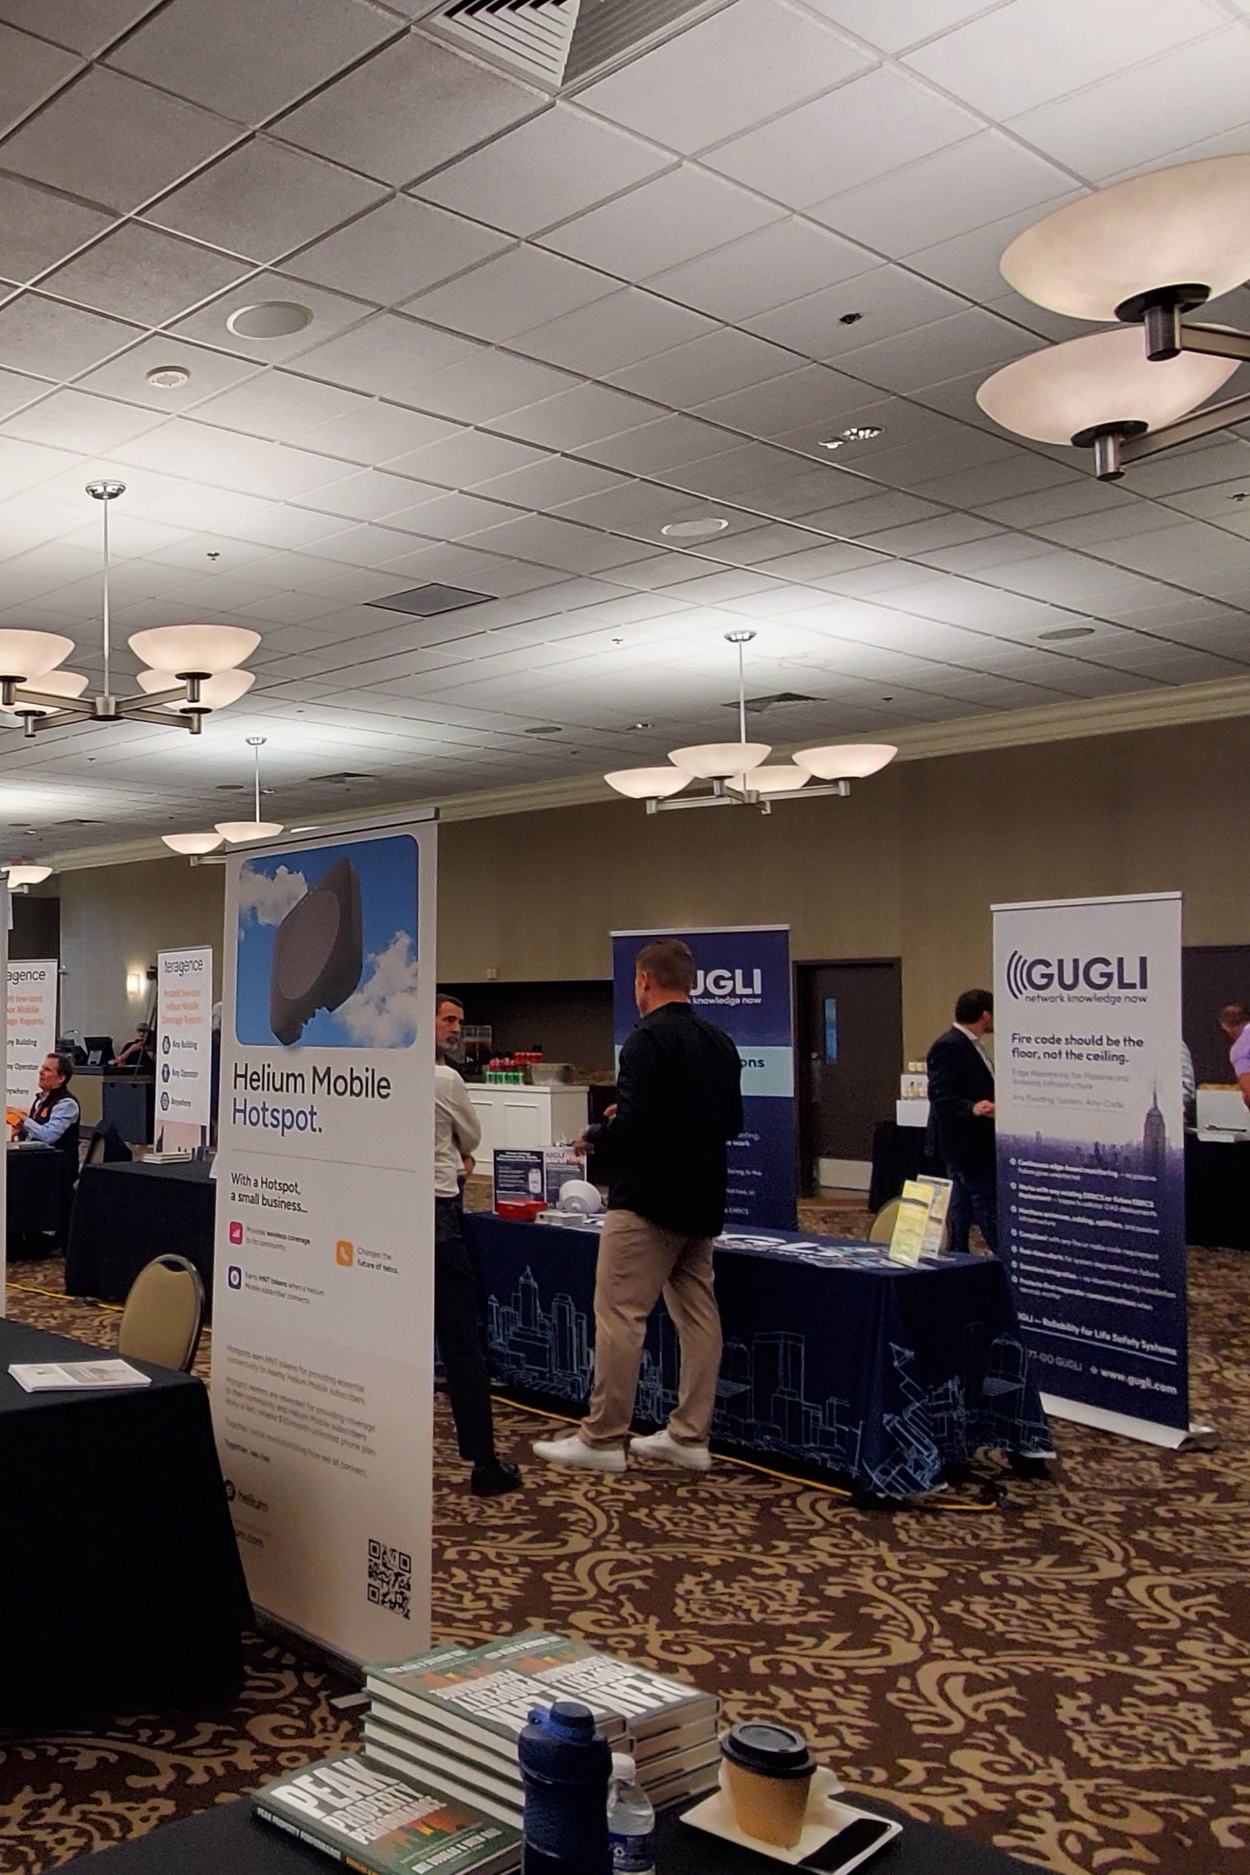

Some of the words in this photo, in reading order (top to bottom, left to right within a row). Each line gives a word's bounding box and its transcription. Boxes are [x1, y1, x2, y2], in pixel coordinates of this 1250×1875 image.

[7, 970, 46, 985] agence
[164, 958, 203, 977] teragence
[1026, 957, 1147, 991] GUGLI
[690, 969, 762, 996] UGLI
[693, 996, 740, 1006] knowledge
[1025, 993, 1065, 1003] network
[1068, 993, 1121, 1006] knowledge
[1125, 995, 1148, 1004] now
[1012, 1033, 1032, 1044] Fire
[1035, 1033, 1062, 1045] code
[1064, 1034, 1103, 1046] should
[1107, 1035, 1120, 1047] be
[1123, 1037, 1144, 1048] the
[1012, 1047, 1041, 1060] floor,
[1043, 1049, 1062, 1060] not
[1065, 1050, 1083, 1061] the
[1086, 1050, 1130, 1066] ceiling.
[6, 1088, 29, 1096] nywhere
[234, 1063, 305, 1094] Helium
[312, 1066, 391, 1099] Mobile
[233, 1097, 322, 1136] Hotspot.
[231, 1172, 251, 1186] With
[253, 1178, 259, 1187] a
[261, 1176, 301, 1195] Hotspot,
[231, 1191, 236, 1201] a
[238, 1191, 259, 1205] small
[357, 1259, 374, 1270] future
[1081, 1326, 1093, 1337] for
[1094, 1328, 1111, 1341] Life
[1112, 1333, 1140, 1349] Safety
[1101, 1368, 1177, 1395] www.gugli.com
[238, 1490, 269, 1513] helium
[577, 1672, 701, 1719] PEAK
[270, 1757, 402, 1820] PEAK
[321, 1782, 426, 1835] PROPERTY
[348, 1795, 449, 1846] PERFORMANCE
